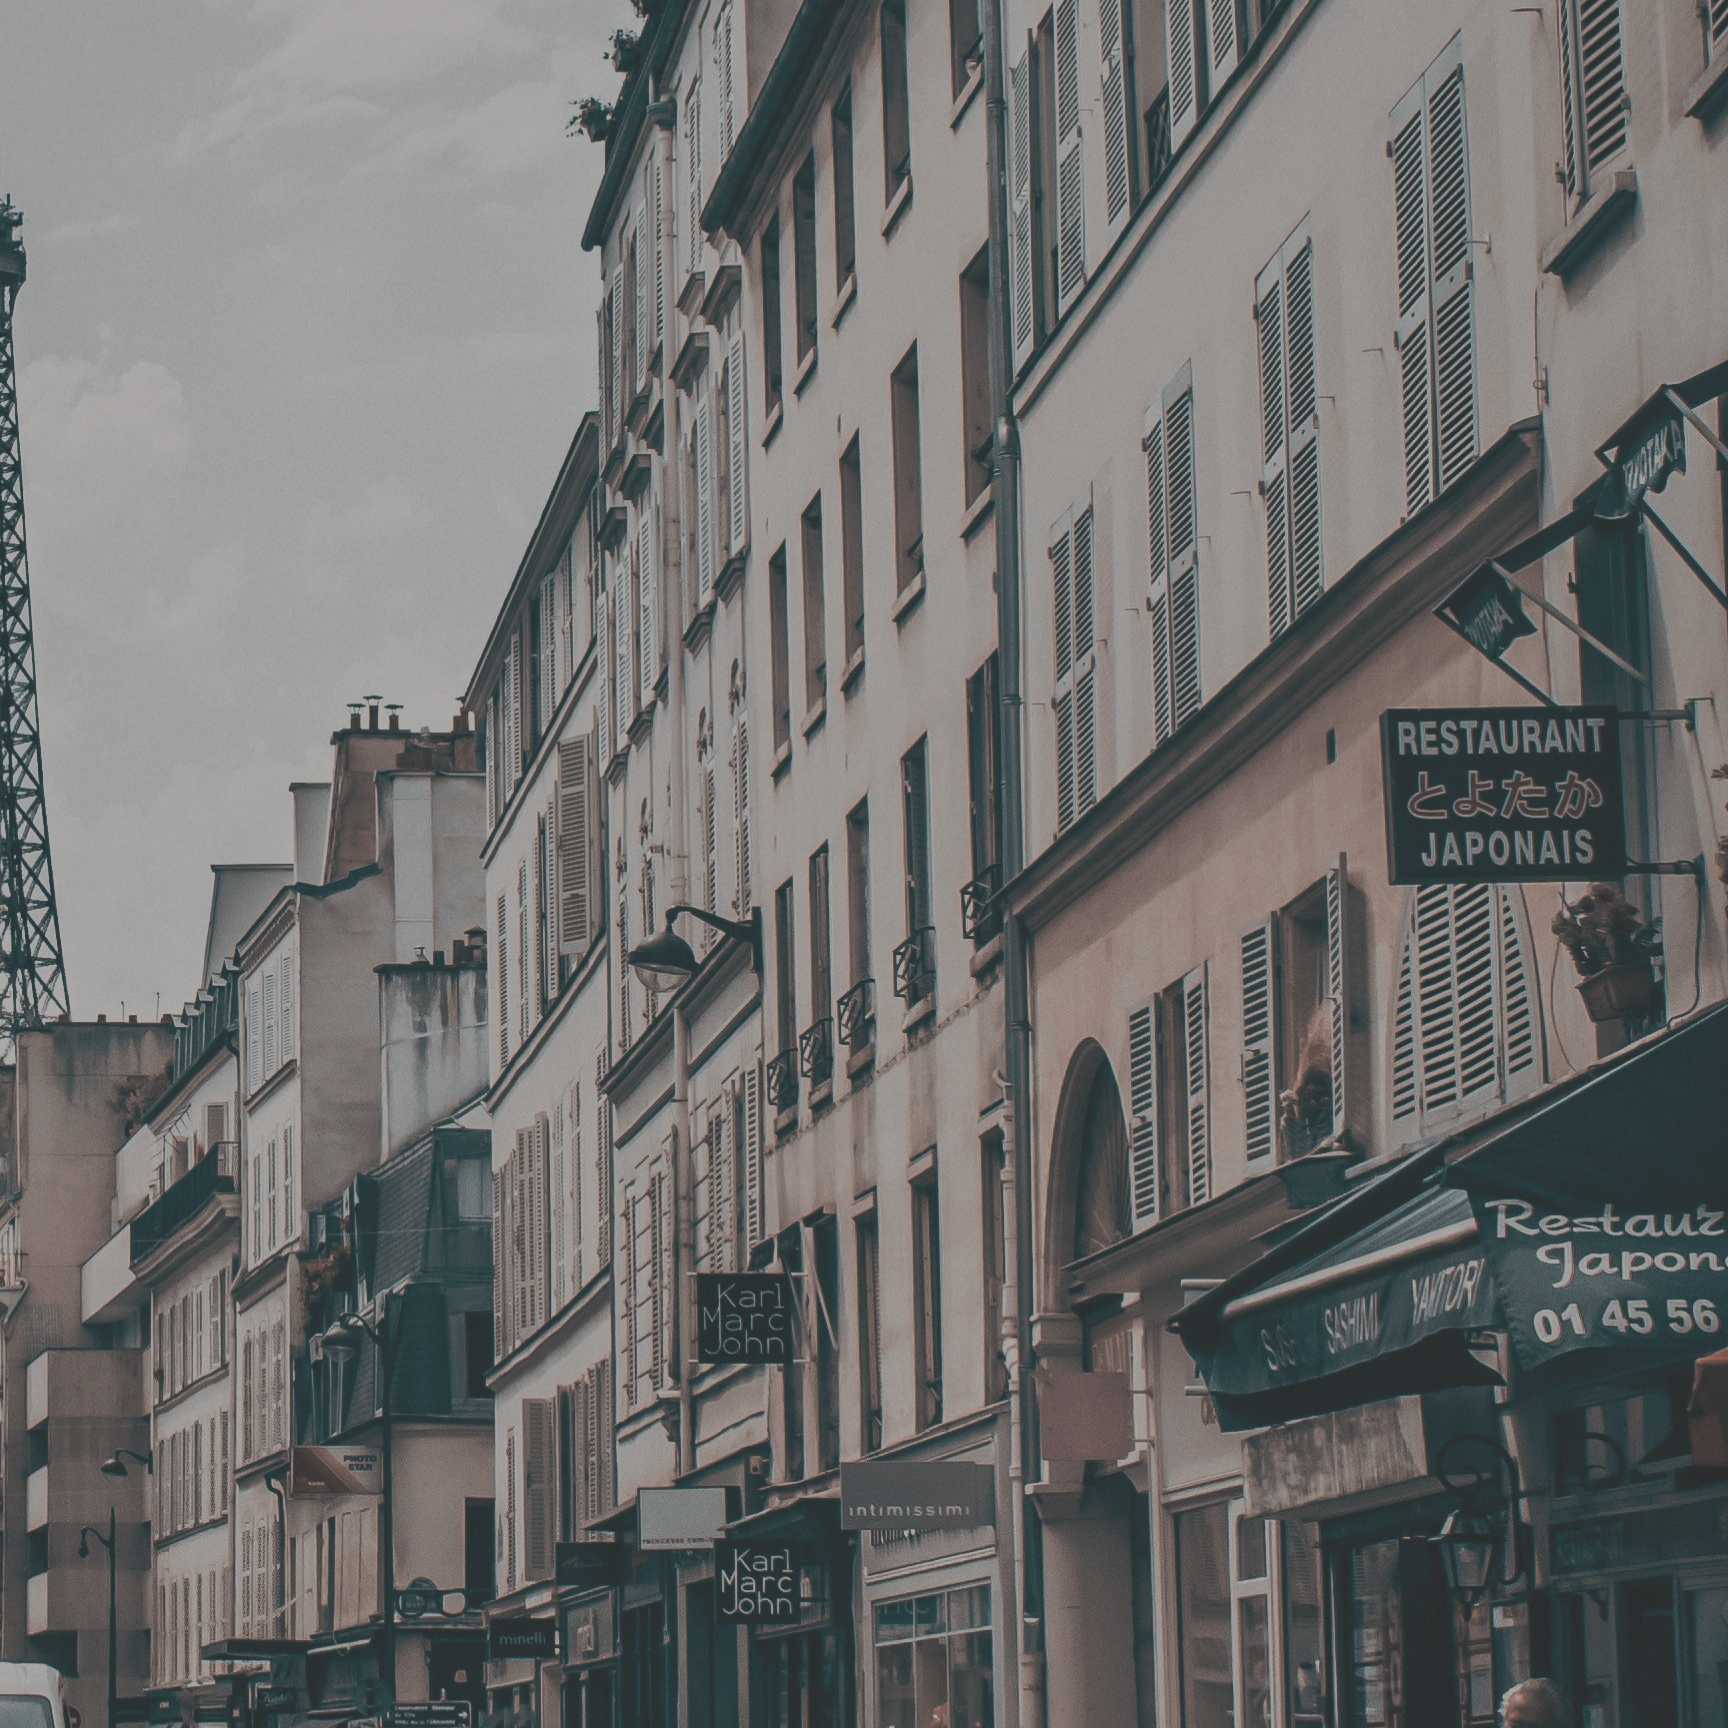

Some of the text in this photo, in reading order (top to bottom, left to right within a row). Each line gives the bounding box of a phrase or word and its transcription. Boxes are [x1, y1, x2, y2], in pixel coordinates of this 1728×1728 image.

[1398, 717, 1606, 756] RESTAURANT
[1407, 769, 1604, 820] とよたか
[1422, 829, 1595, 868] JAPONAIS
[1536, 1240, 1728, 1289] Japon
[717, 1282, 785, 1309] Karl
[703, 1305, 785, 1332] Marc
[1324, 1290, 1381, 1355] SASHIMI
[1533, 1299, 1720, 1344] 01 45 56
[704, 1327, 785, 1355] John
[848, 1502, 971, 1518] intimissimi
[733, 1548, 793, 1573] Karl
[720, 1569, 793, 1593] Marc
[721, 1590, 793, 1615] John
[497, 1630, 547, 1646] minelli
